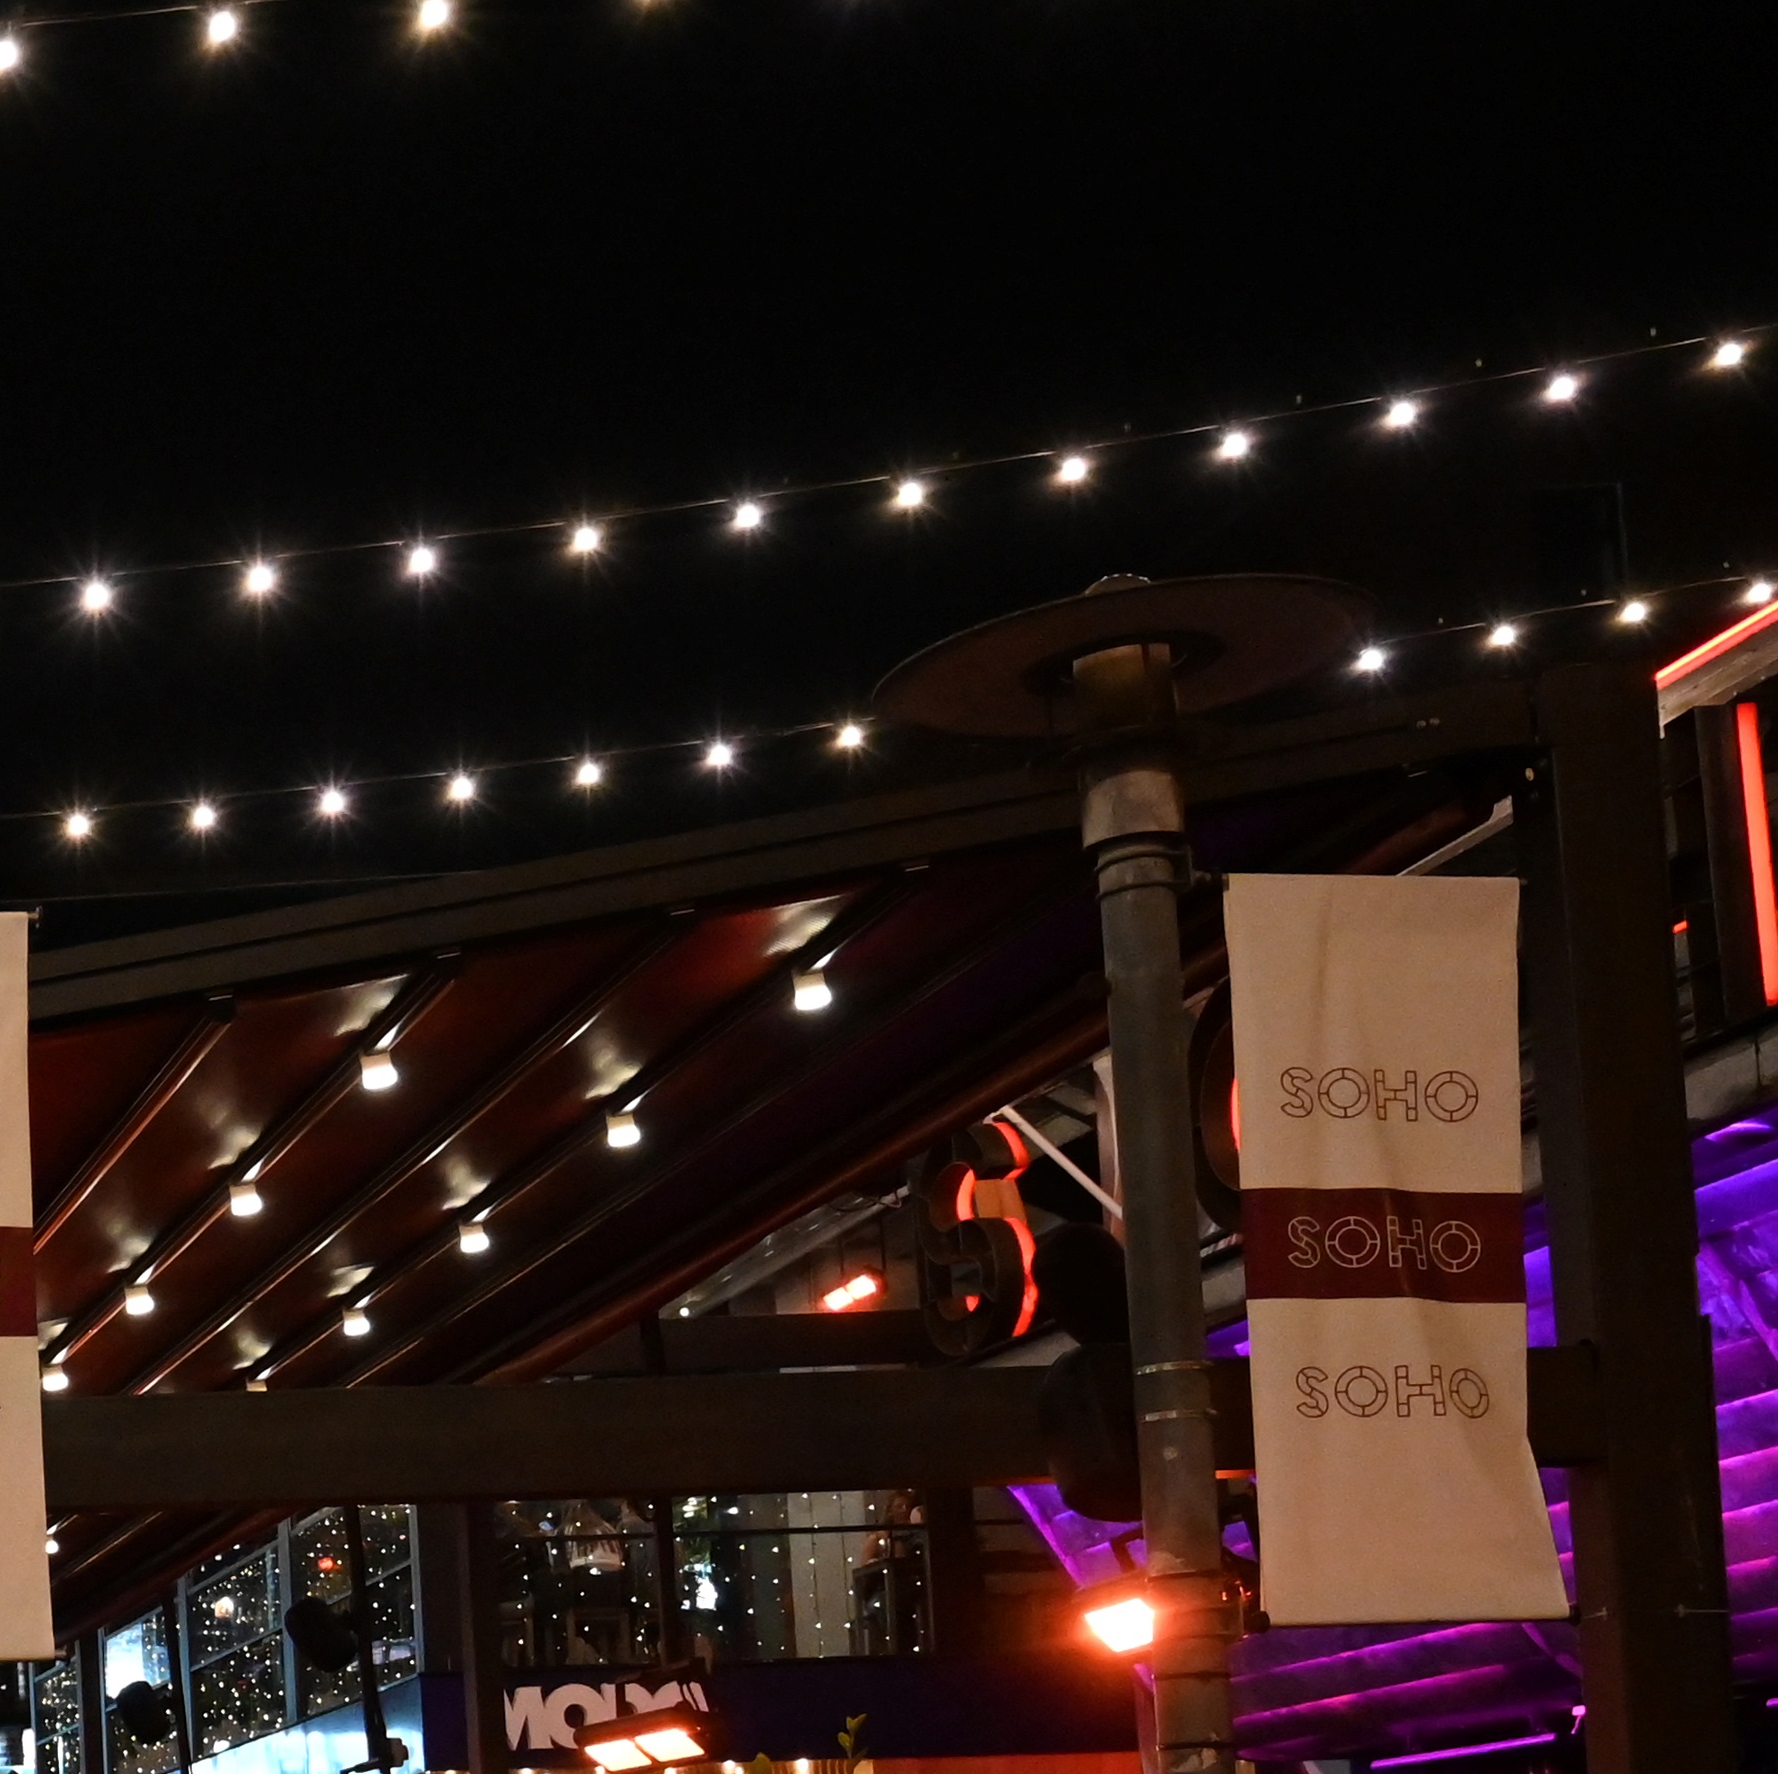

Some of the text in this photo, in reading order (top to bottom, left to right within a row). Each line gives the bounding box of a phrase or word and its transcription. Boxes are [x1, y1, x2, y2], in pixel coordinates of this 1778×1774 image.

[1280, 1067, 1478, 1122] SOHO
[1287, 1216, 1481, 1272] SOHO
[1295, 1366, 1489, 1419] SOHO
